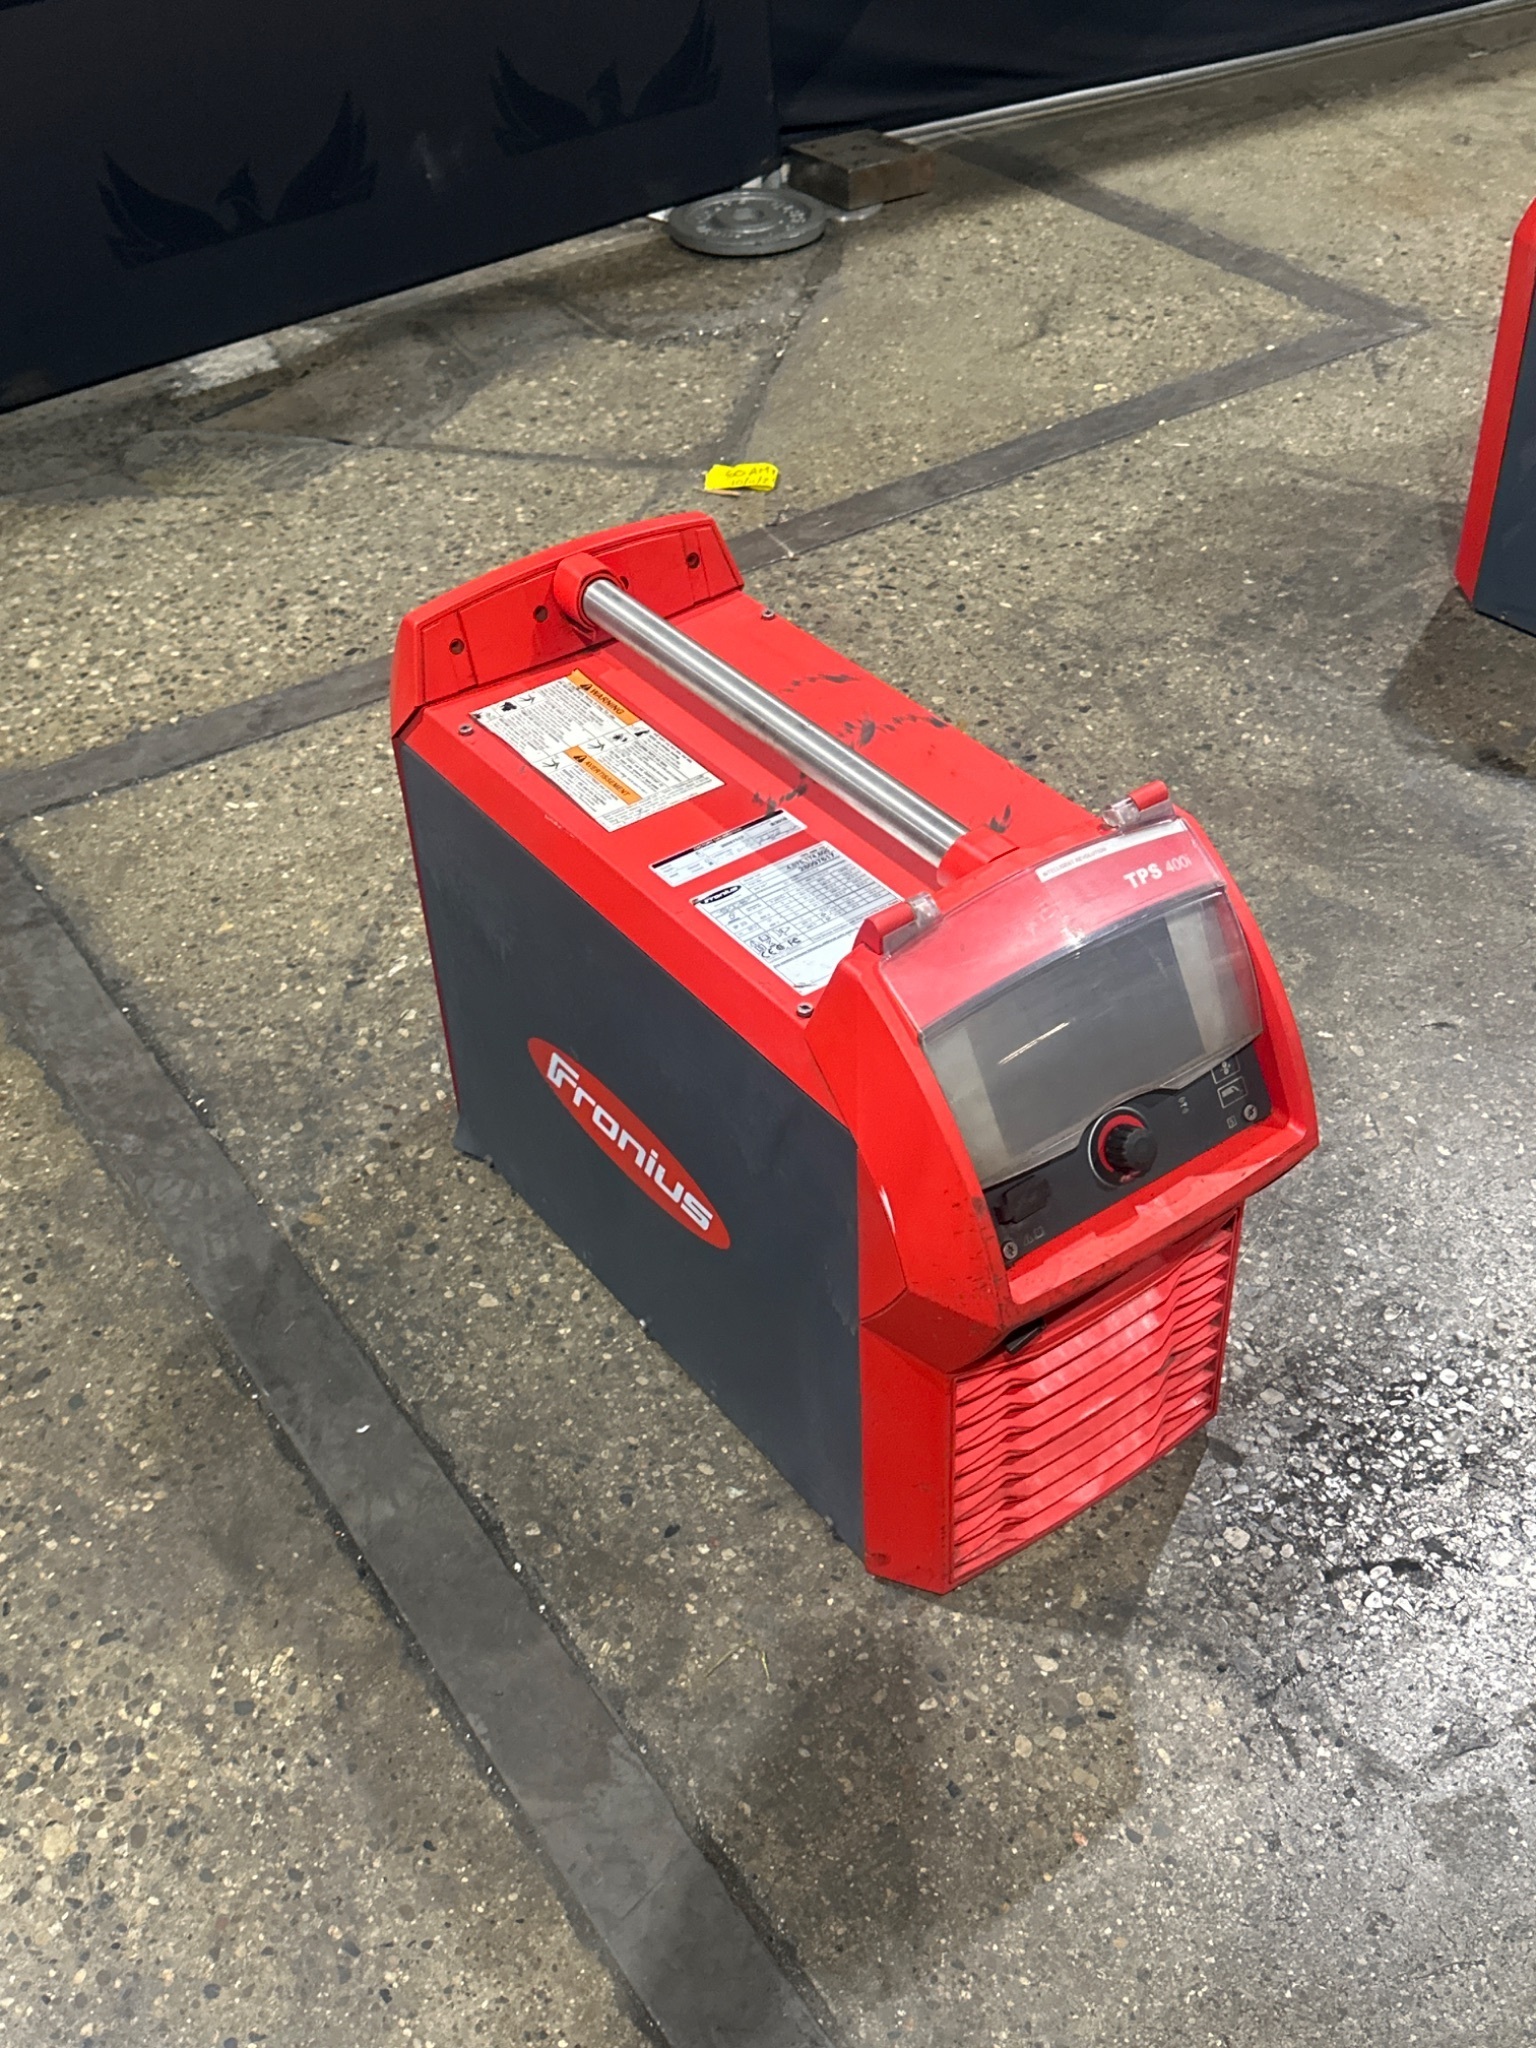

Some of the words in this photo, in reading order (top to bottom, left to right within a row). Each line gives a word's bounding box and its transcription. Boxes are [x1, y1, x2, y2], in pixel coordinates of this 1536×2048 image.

[590, 688, 625, 715] WARNING
[585, 761, 631, 796] AVERTISSEMENT
[1123, 862, 1163, 889] TPS
[1166, 853, 1192, 872] 400i
[547, 1052, 713, 1231] Fronius
